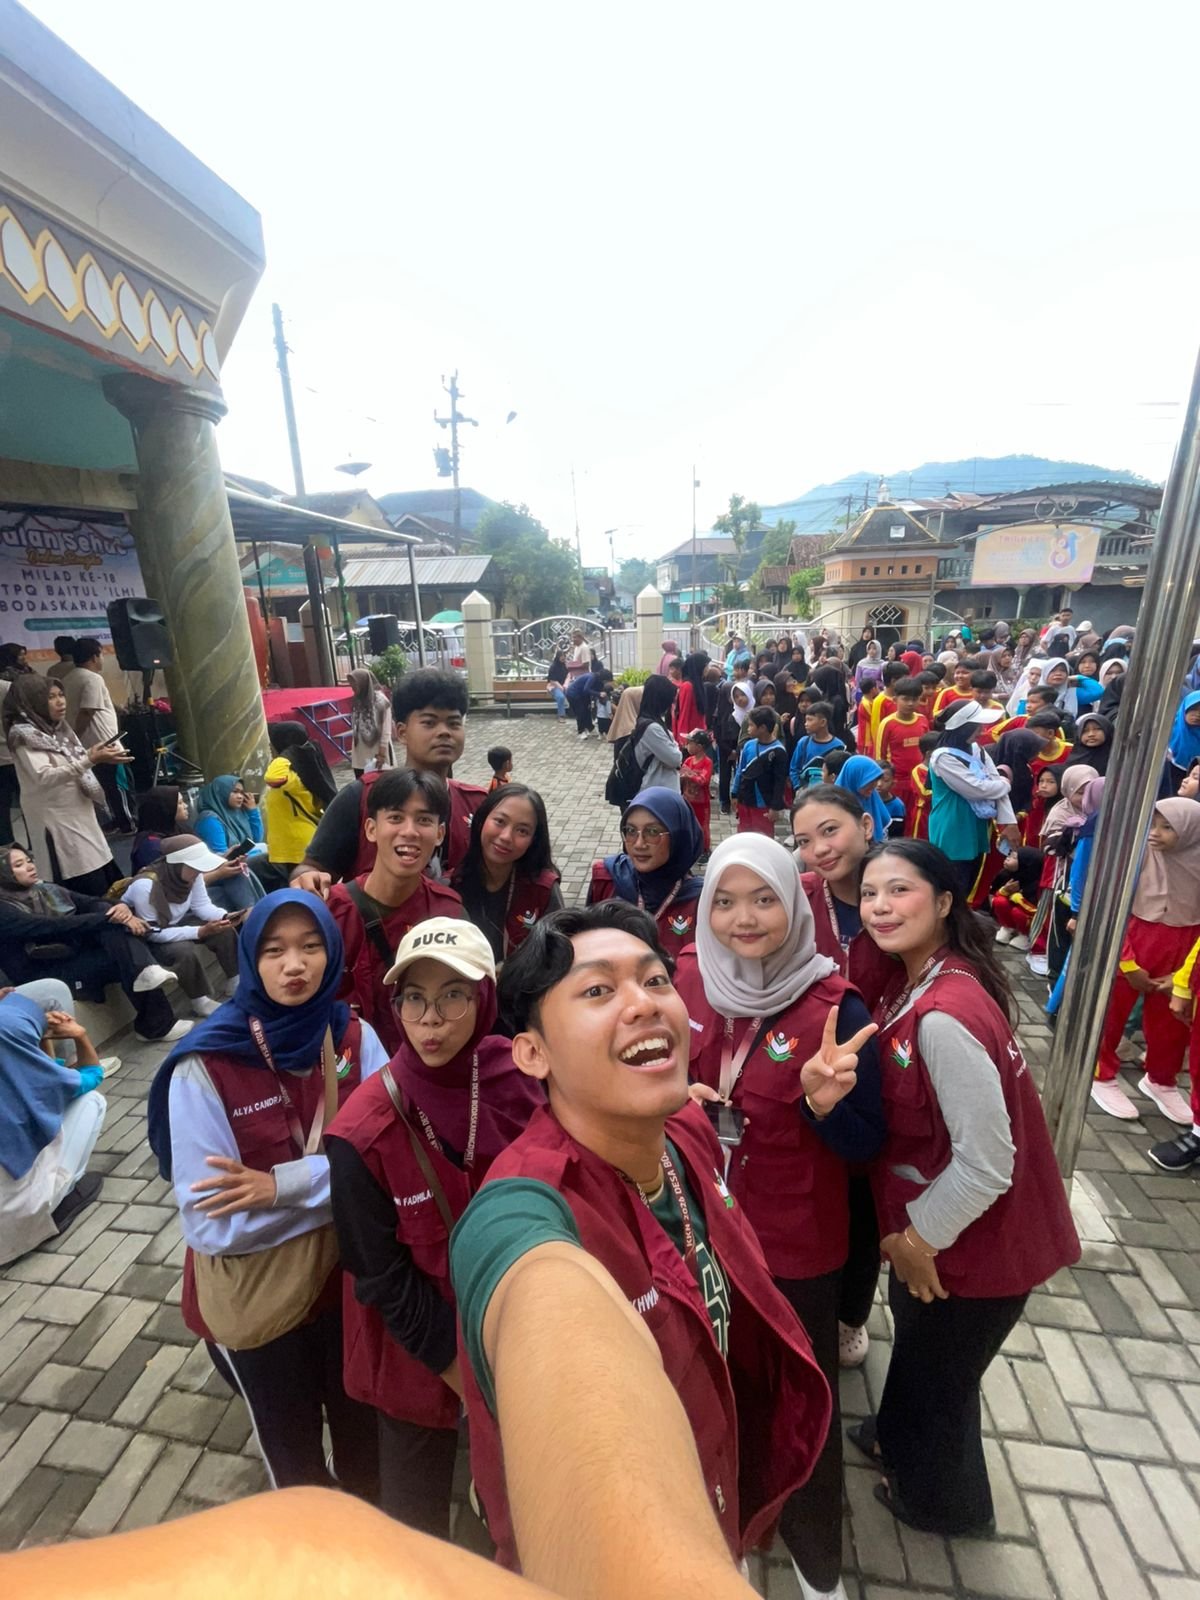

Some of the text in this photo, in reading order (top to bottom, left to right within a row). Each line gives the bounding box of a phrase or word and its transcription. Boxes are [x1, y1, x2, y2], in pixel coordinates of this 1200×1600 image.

[22, 569, 116, 583] MILAD KE-18
[0, 584, 37, 596] TPQ
[45, 584, 98, 597] BAITUL
[0, 600, 107, 612] BODASKARAN
[412, 932, 458, 949] BUCK
[233, 1105, 253, 1117] ALYA
[667, 1169, 682, 1195] DESA
[403, 1189, 434, 1207] FADHILA
[678, 1196, 690, 1221] 2026
